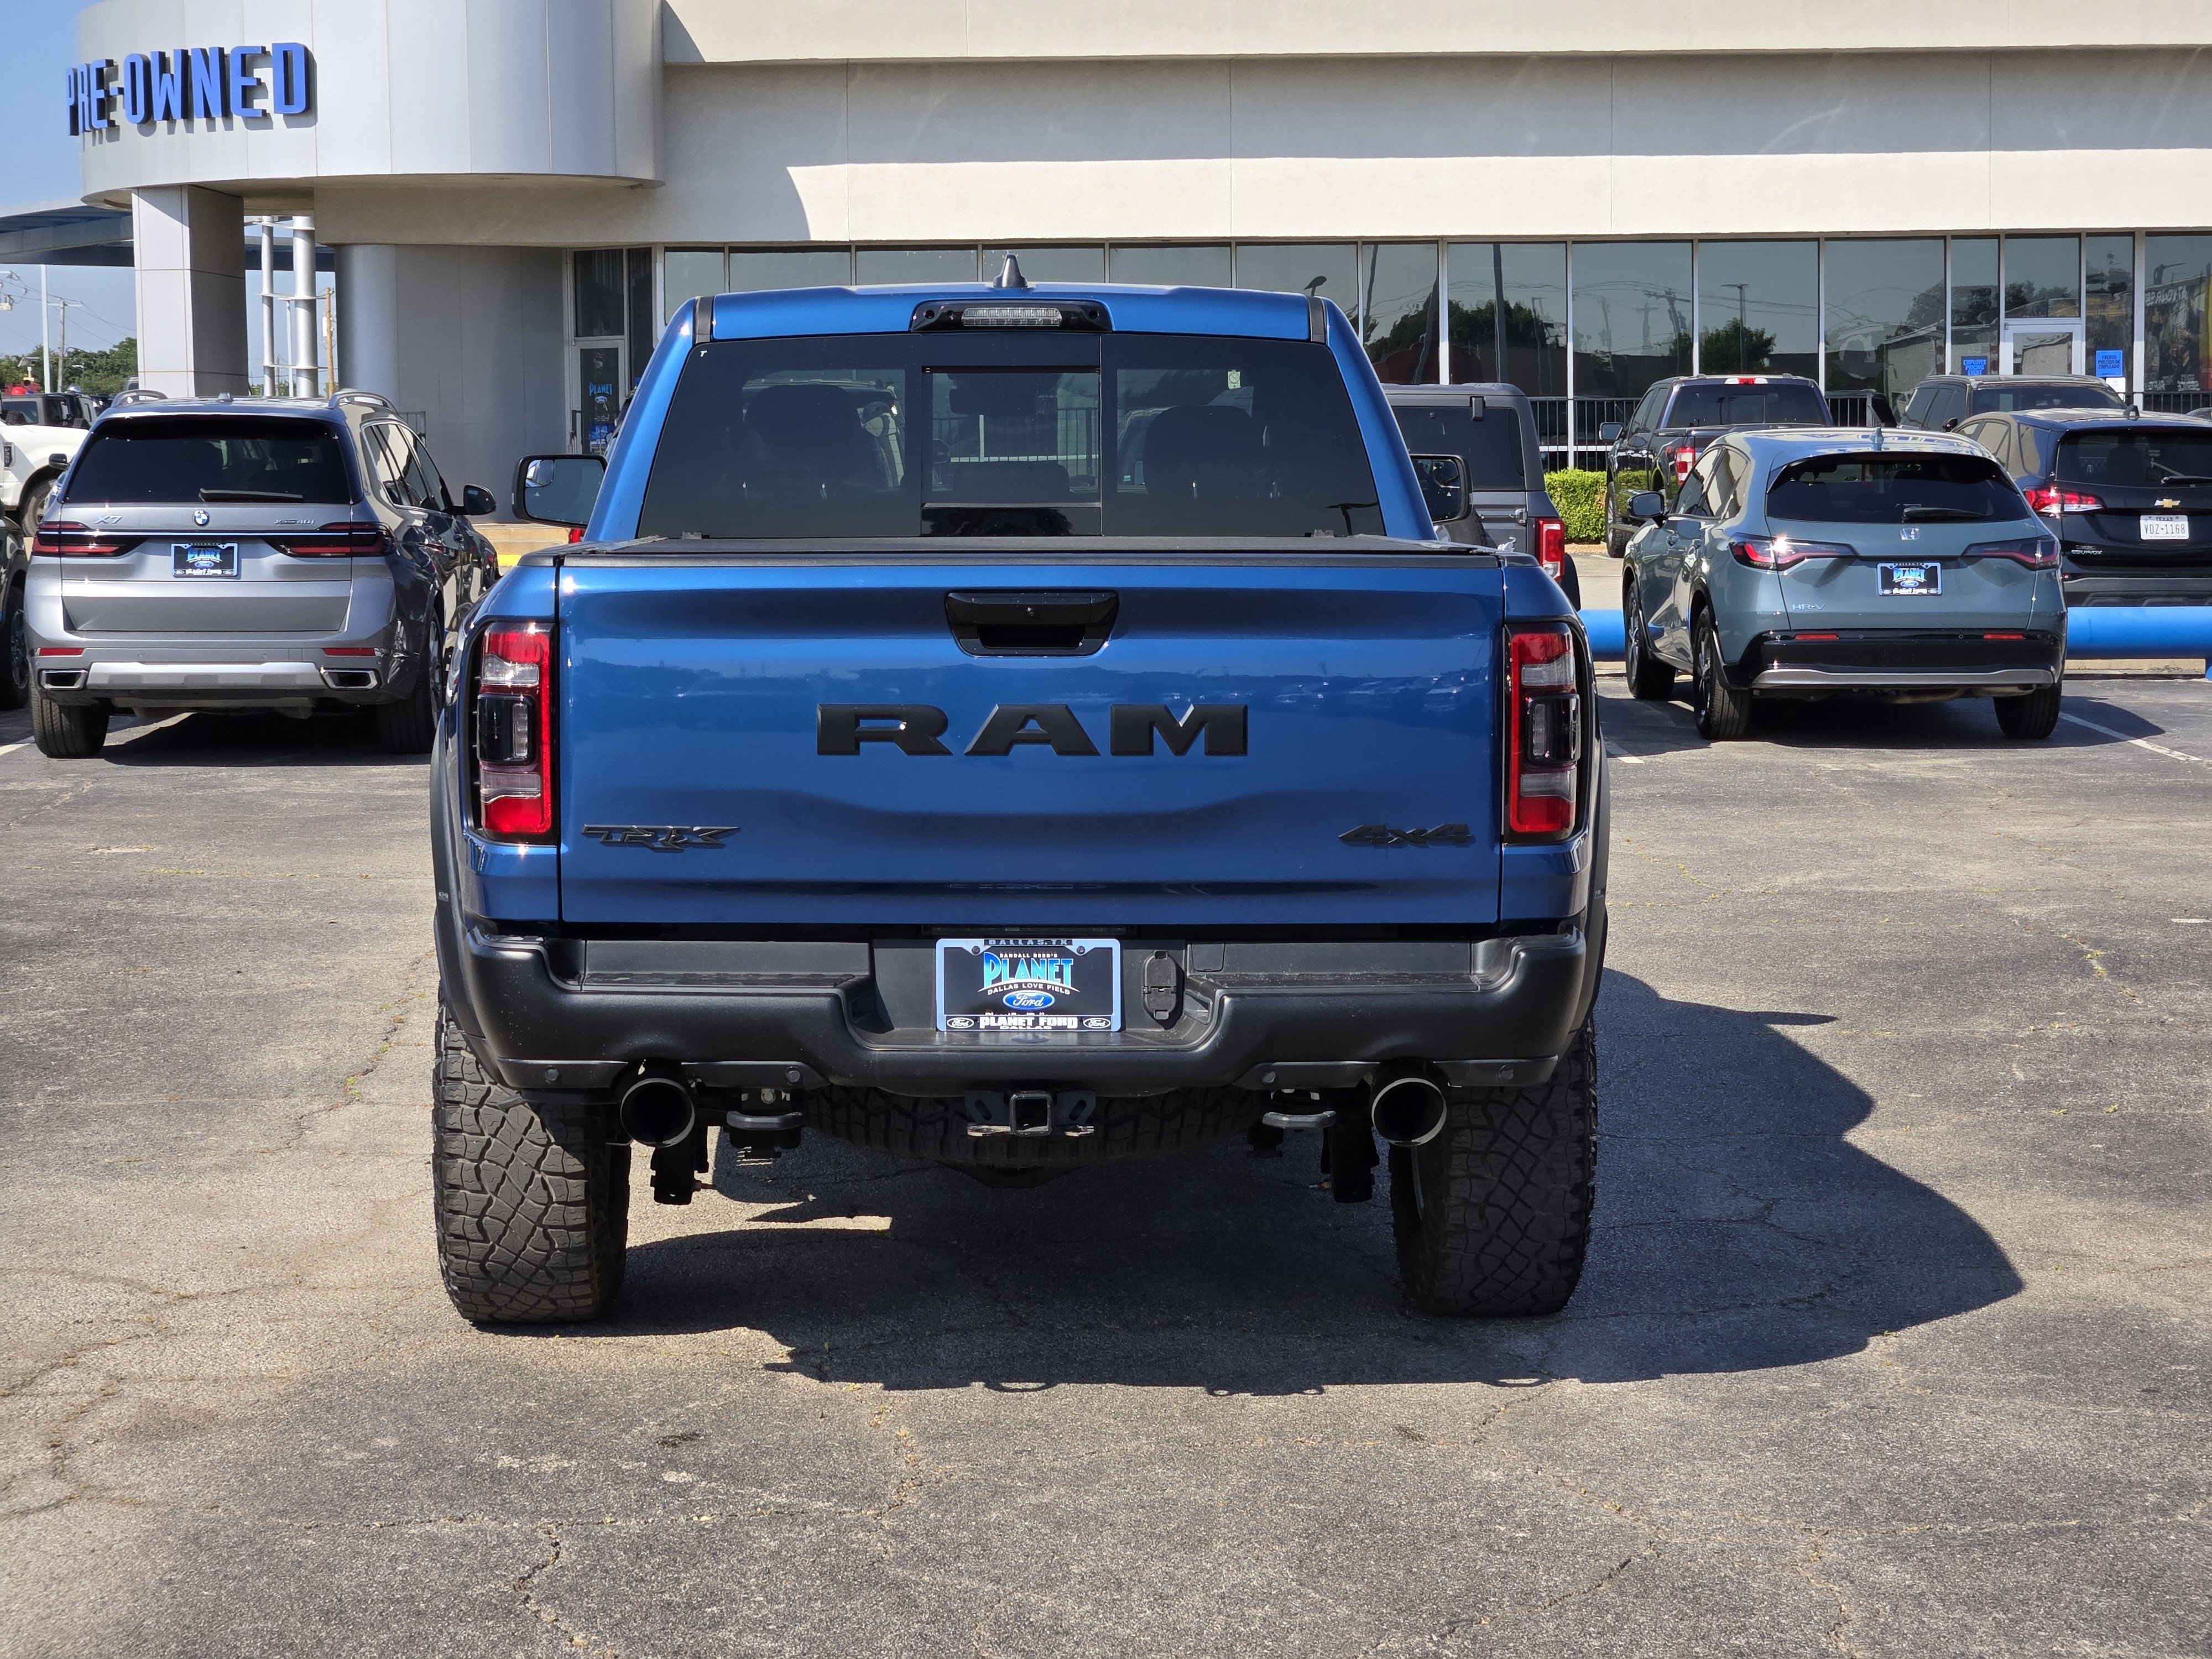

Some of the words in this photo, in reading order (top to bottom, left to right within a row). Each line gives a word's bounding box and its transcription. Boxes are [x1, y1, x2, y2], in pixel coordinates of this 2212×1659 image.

[66, 42, 309, 136] PRE-OWNED
[589, 382, 613, 396] PLANET
[93, 515, 123, 524] X7
[817, 703, 1249, 756] RAM
[581, 824, 740, 852] TRX
[983, 951, 1074, 988] PLANET
[987, 983, 1019, 995] DALLAS
[1047, 984, 1071, 995] FIELD
[979, 1016, 1035, 1029] PLANET
[1039, 1016, 1078, 1029] FORD
